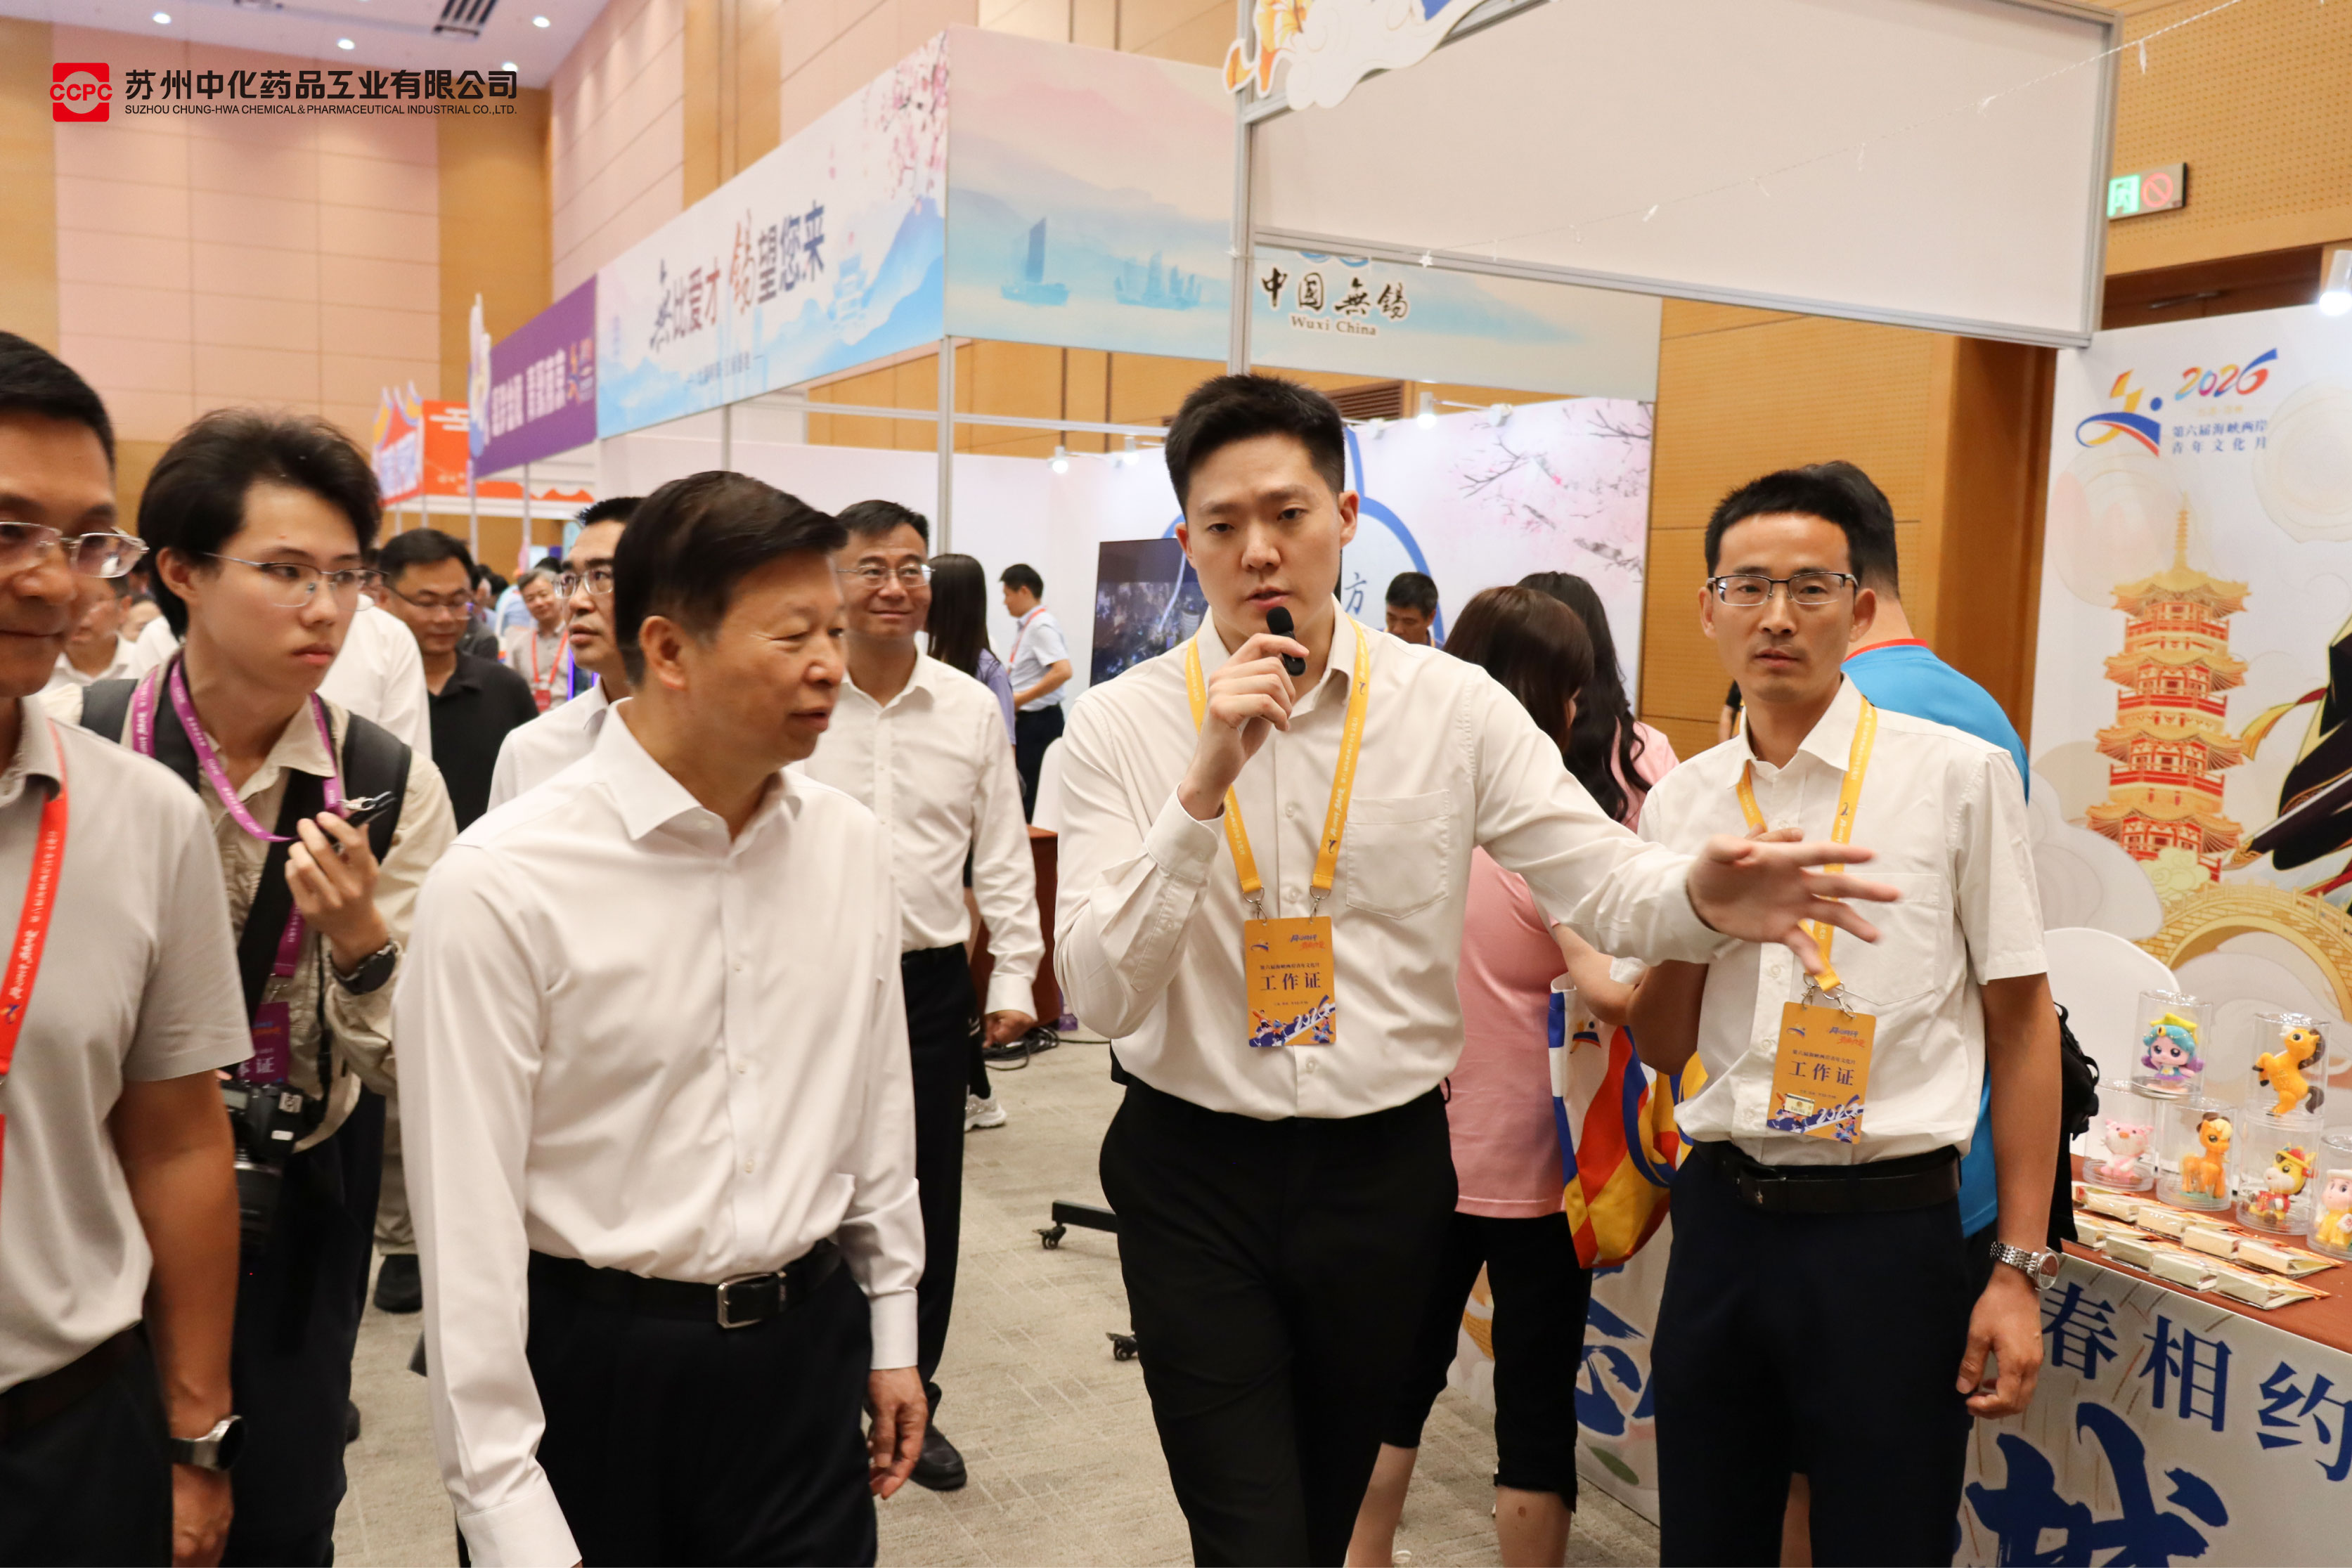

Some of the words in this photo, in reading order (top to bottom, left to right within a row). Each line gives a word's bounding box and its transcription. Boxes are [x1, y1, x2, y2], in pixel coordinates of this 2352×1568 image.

[1291, 315, 1330, 331] Wuxi
[1336, 320, 1377, 336] China
[2173, 347, 2277, 401] 2026
[2173, 420, 2268, 438] 第六届海峡两岸
[2172, 436, 2267, 455] 青年文化月
[1259, 971, 1322, 992] 工作证
[1788, 1060, 1856, 1087] 工作证
[2041, 1281, 2352, 1482] 春相约
